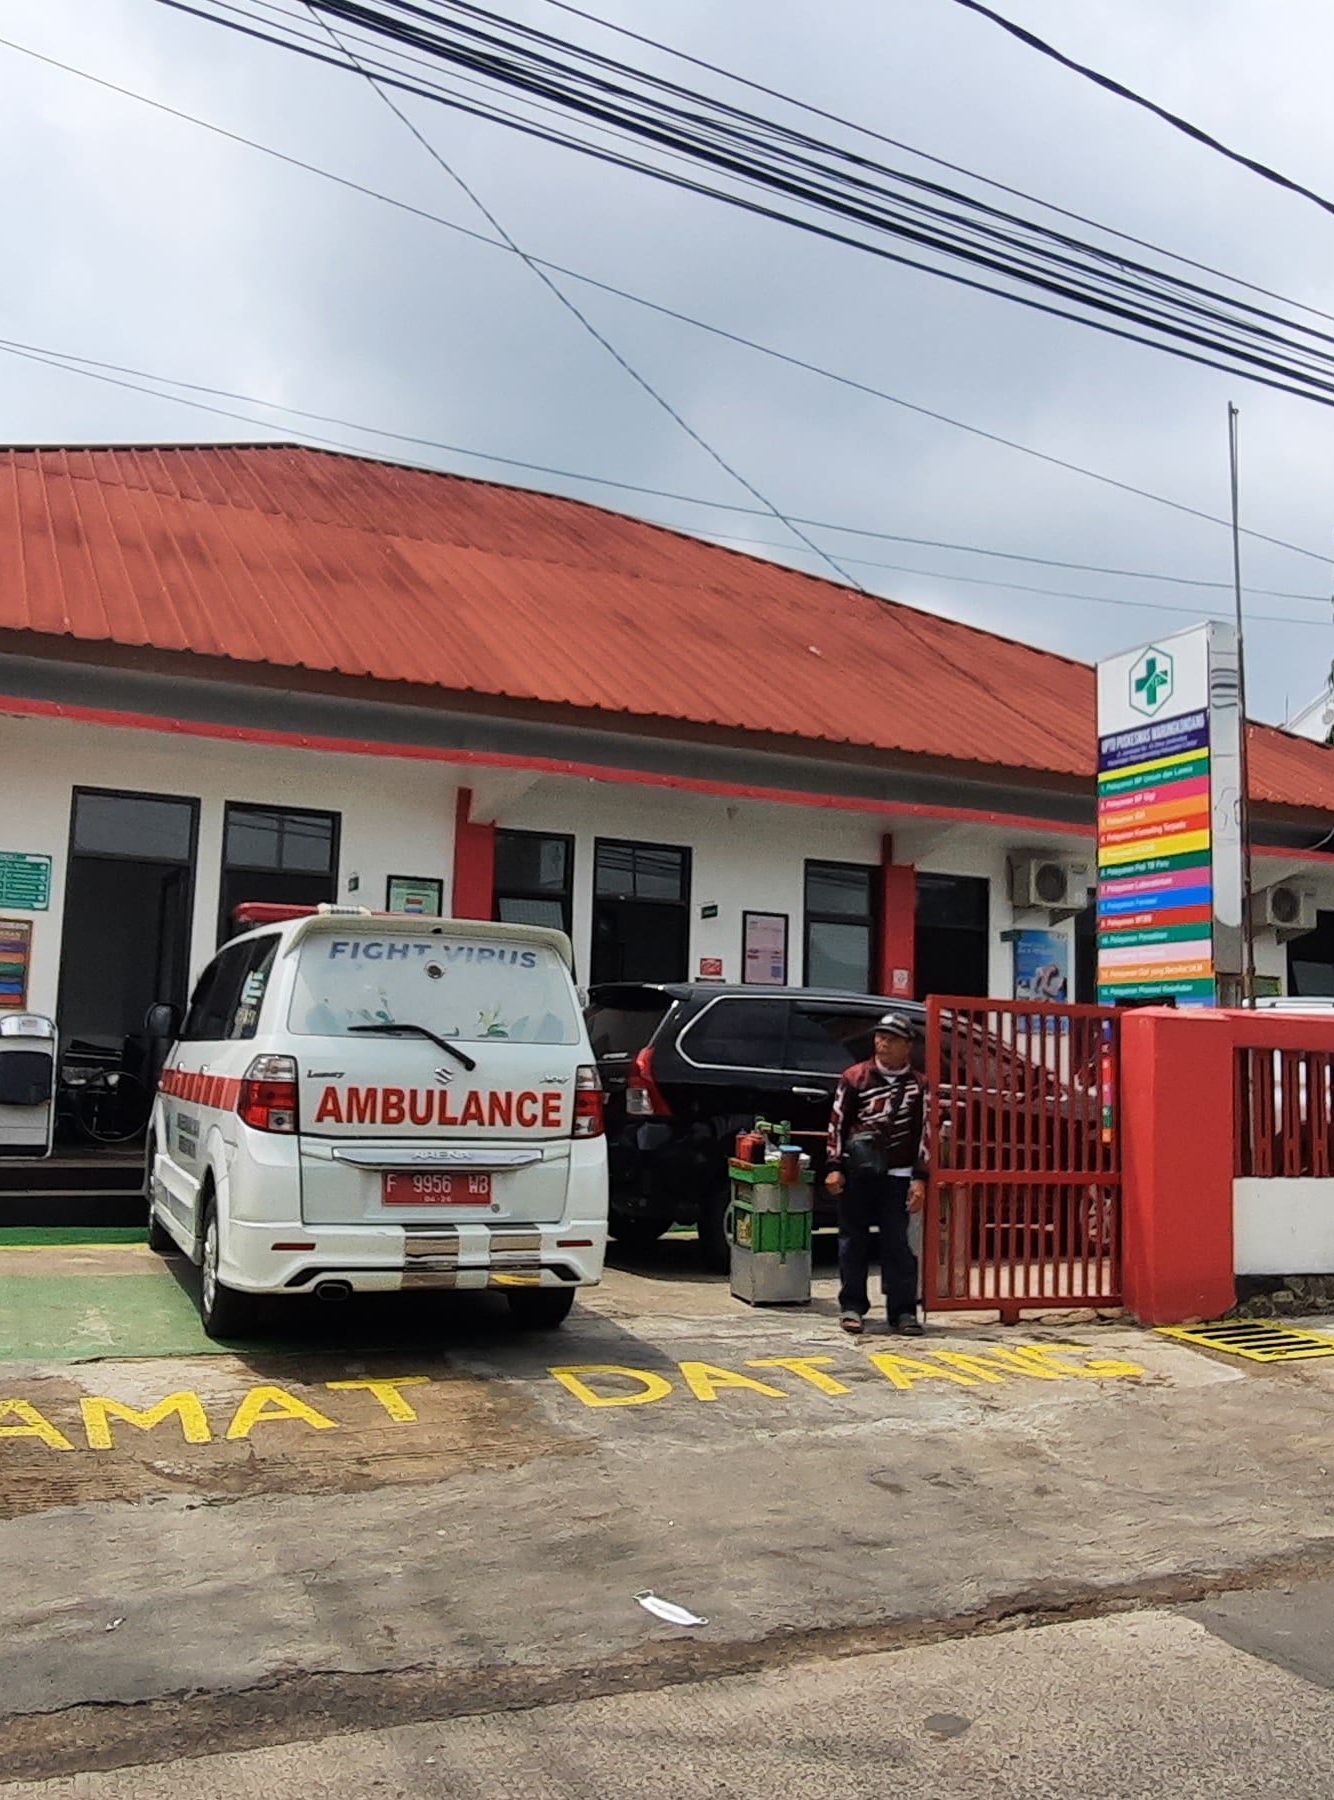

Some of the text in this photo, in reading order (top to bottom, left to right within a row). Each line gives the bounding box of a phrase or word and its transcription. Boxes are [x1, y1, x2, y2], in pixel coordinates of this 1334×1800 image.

[328, 941, 431, 961] FIGHT
[315, 1086, 562, 1128] AMBULANCE
[386, 1173, 489, 1194] F 9956 WB
[547, 1344, 1147, 1407] DATANG
